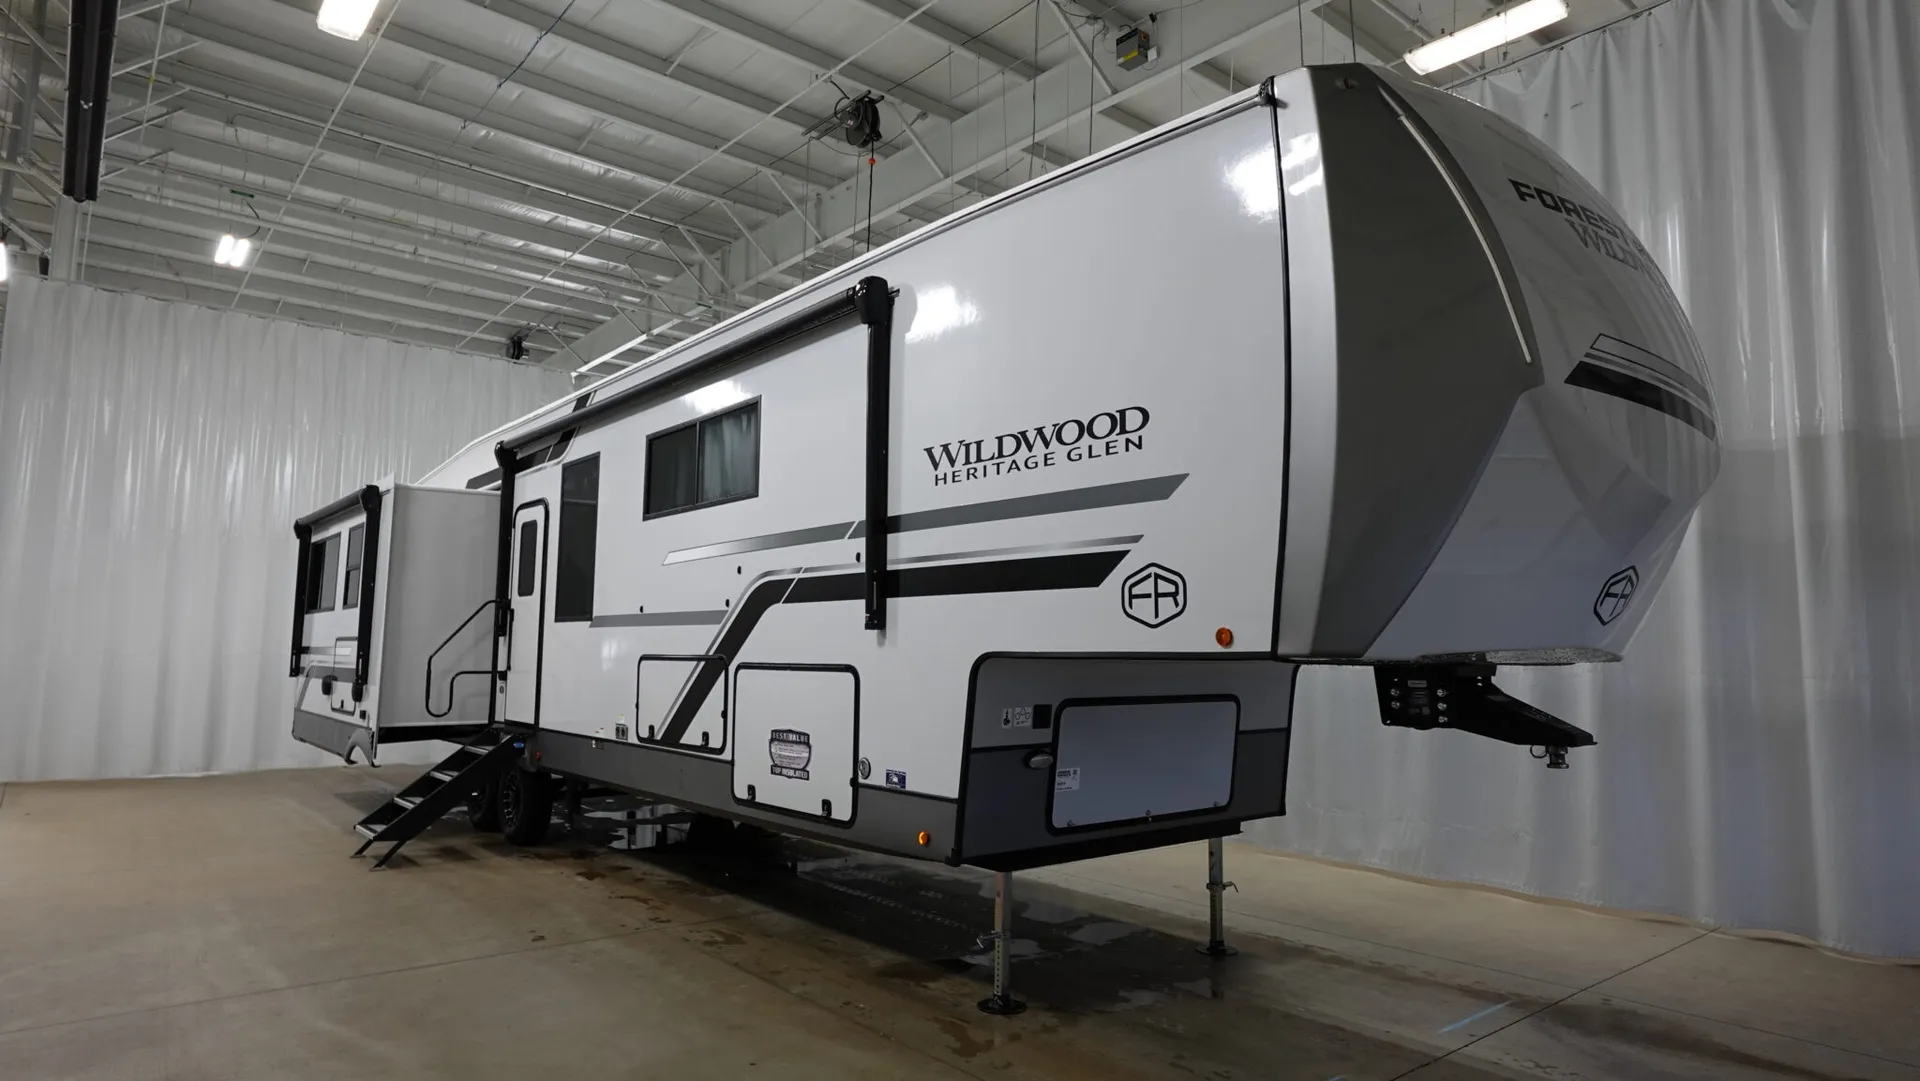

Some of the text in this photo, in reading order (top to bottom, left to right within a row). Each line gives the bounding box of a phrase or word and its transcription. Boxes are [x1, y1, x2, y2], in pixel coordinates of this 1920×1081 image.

[923, 406, 1150, 471] WILDWOOD
[934, 435, 1144, 487] HERITAGE GLEN
